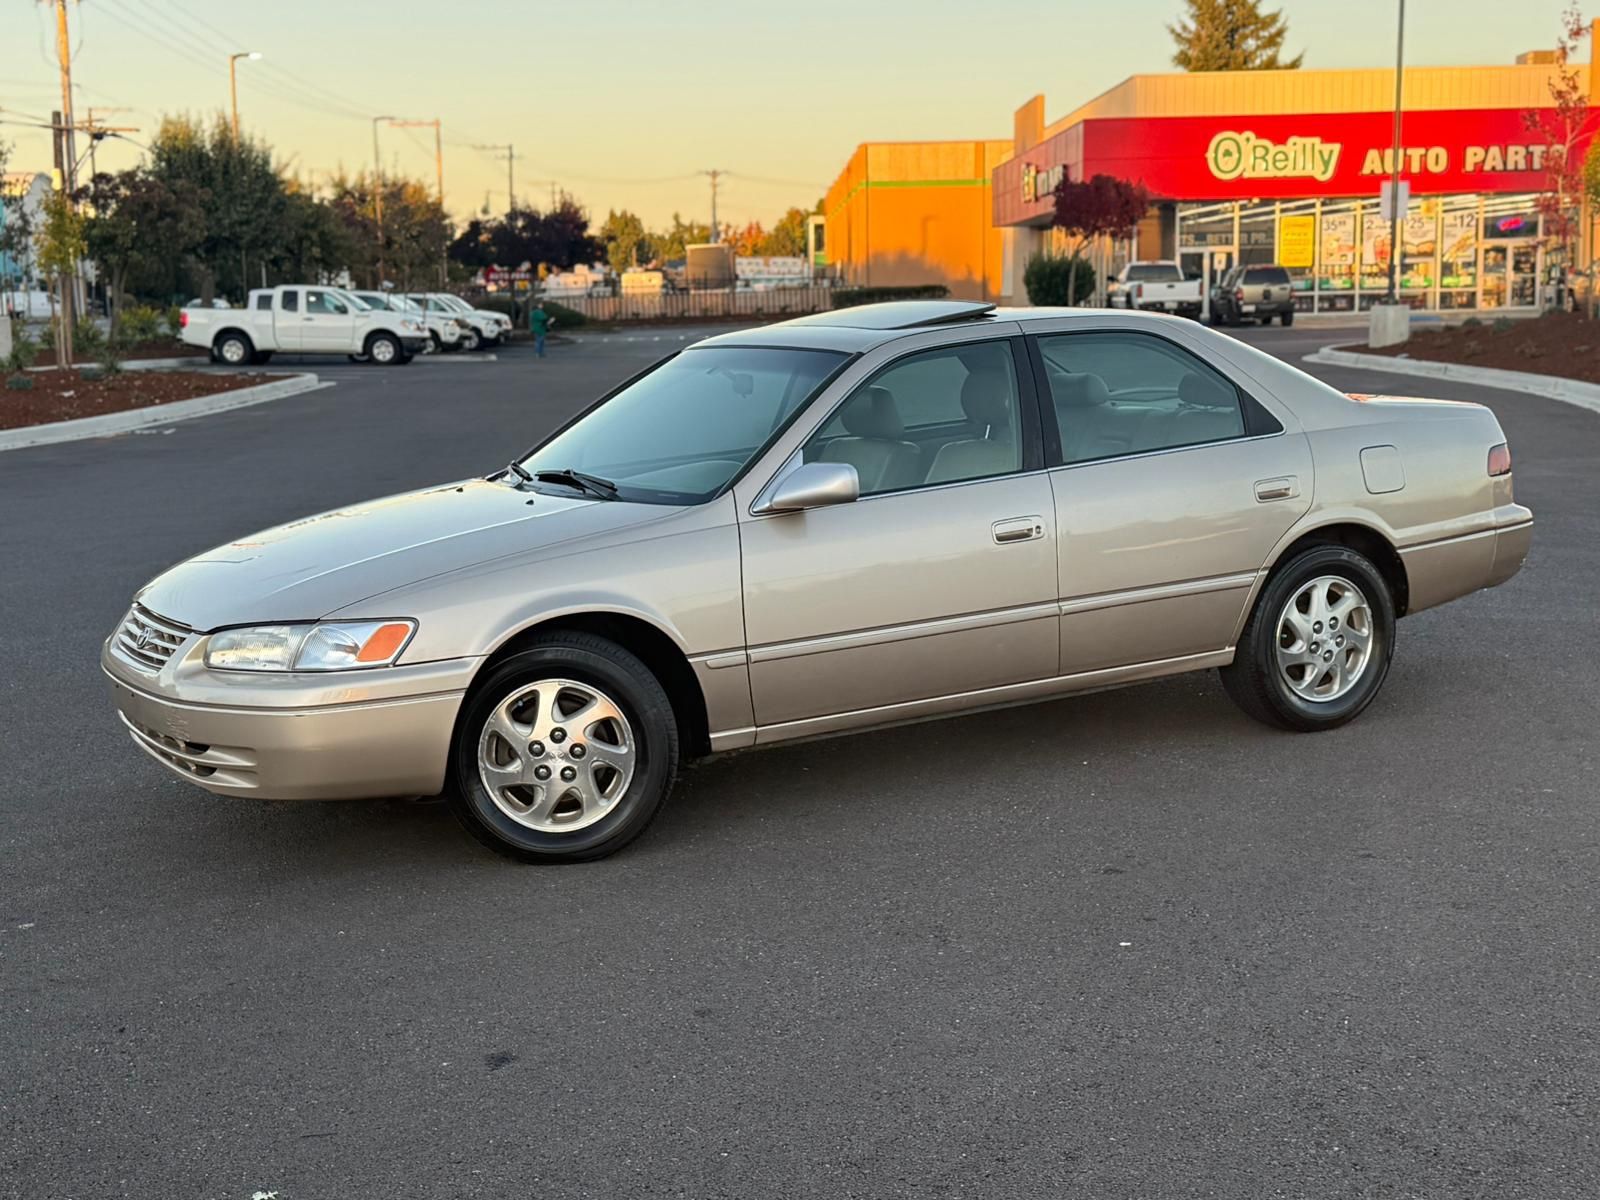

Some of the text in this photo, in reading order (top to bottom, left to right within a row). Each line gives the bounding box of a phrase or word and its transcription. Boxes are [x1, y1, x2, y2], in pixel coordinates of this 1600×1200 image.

[1211, 134, 1337, 178] O'Reilly
[1361, 147, 1448, 175] AUTO
[1207, 232, 1248, 246] BETTR
